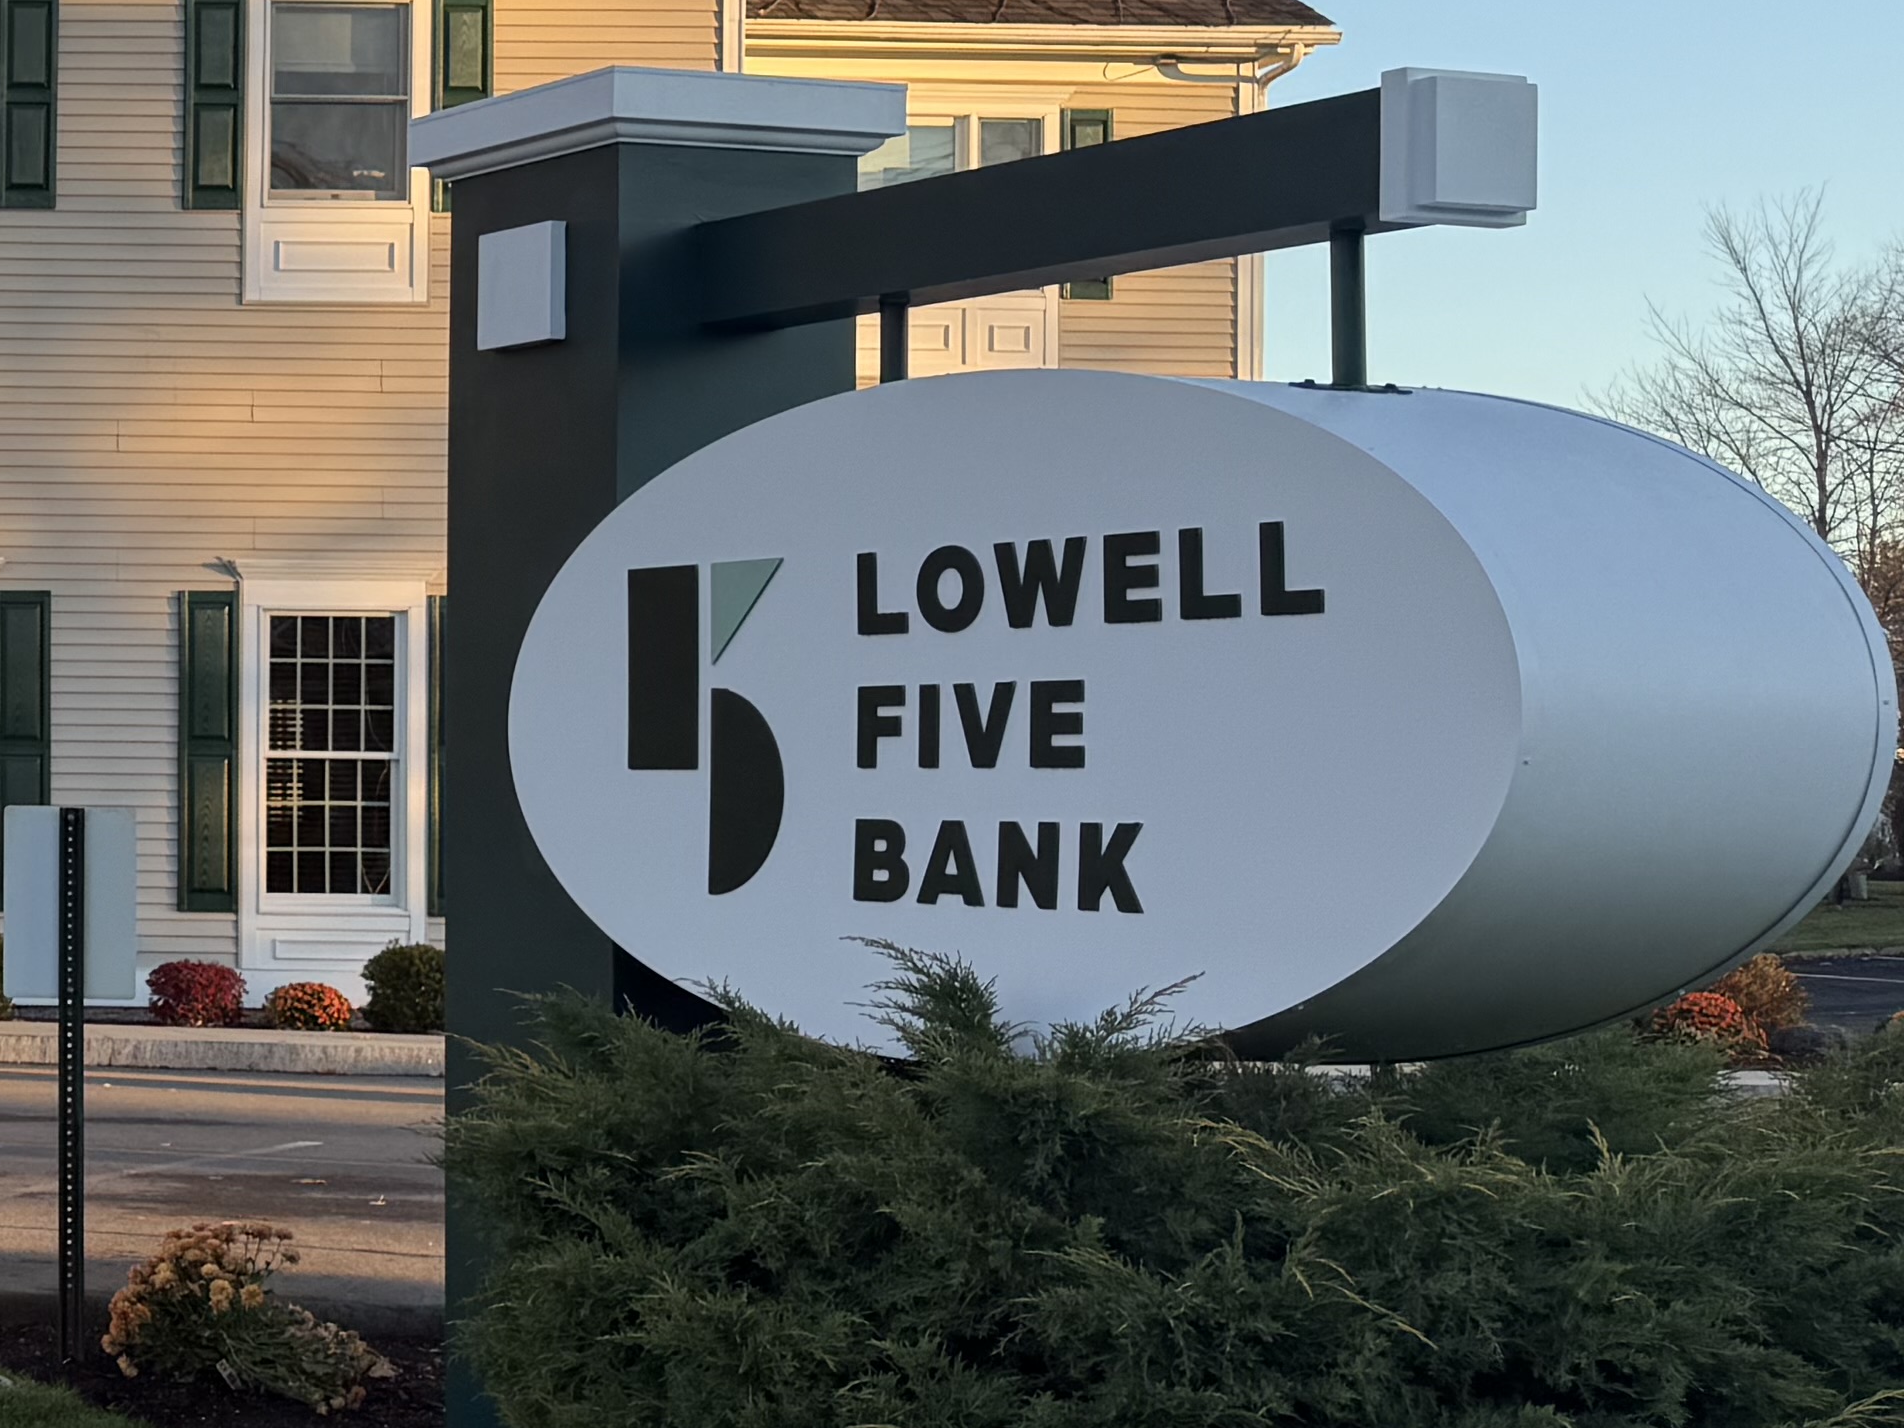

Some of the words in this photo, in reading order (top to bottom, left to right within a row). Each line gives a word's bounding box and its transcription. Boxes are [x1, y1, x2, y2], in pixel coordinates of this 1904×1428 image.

[852, 520, 1326, 637] LOWELL
[856, 679, 1086, 770] FIVE
[852, 818, 1145, 914] BANK
